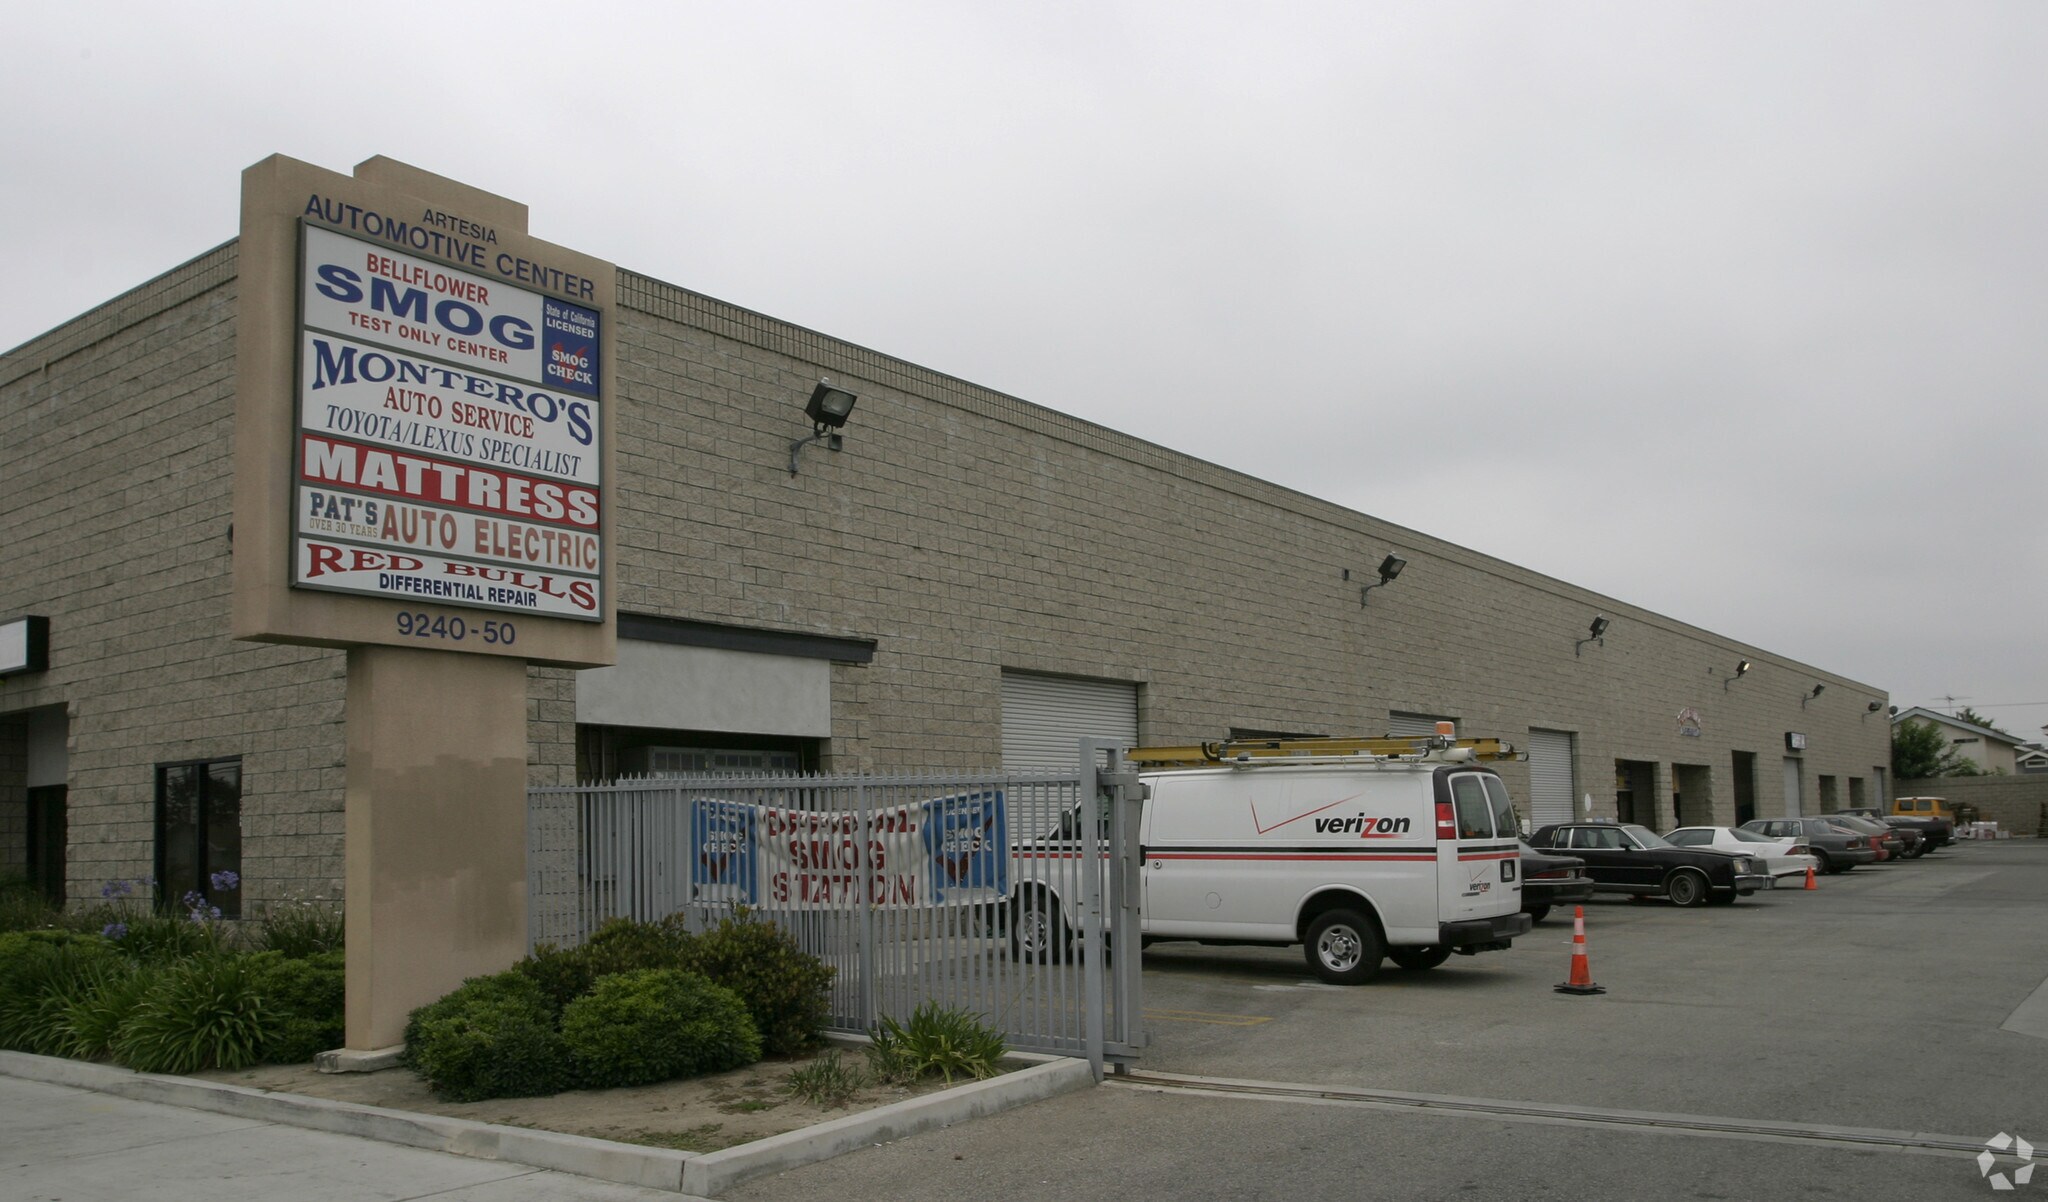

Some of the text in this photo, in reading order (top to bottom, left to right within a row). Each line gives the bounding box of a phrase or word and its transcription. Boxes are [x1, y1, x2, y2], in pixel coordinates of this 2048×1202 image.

[305, 194, 594, 300] AUTOMOTIVE CENTER
[423, 208, 498, 245] ARTESIA
[366, 252, 489, 306] BELLFLOWER
[315, 264, 535, 350] SMOG
[546, 303, 596, 328] State of California
[546, 317, 595, 339] LICENSED
[349, 311, 508, 364] TEST ONLY CENTER
[551, 349, 589, 369] SMOG
[312, 339, 593, 446] MONTERO'S
[547, 363, 593, 385] CHECK
[383, 386, 535, 439] AUTO SERVICE
[326, 404, 582, 477] TOYOTA/LEXUS SPECIALIST
[304, 438, 599, 526] MATTRESS
[309, 517, 378, 539] OVER 30 YEARS
[310, 491, 597, 571] PAT'S AUTO ELECTRIC
[306, 542, 597, 611] RED BULLS
[379, 572, 537, 608] DIFFERENTIAL REPAIR
[396, 611, 516, 646] 9240-50
[1314, 811, 1411, 839] verizon
[1469, 880, 1491, 893] verizon
